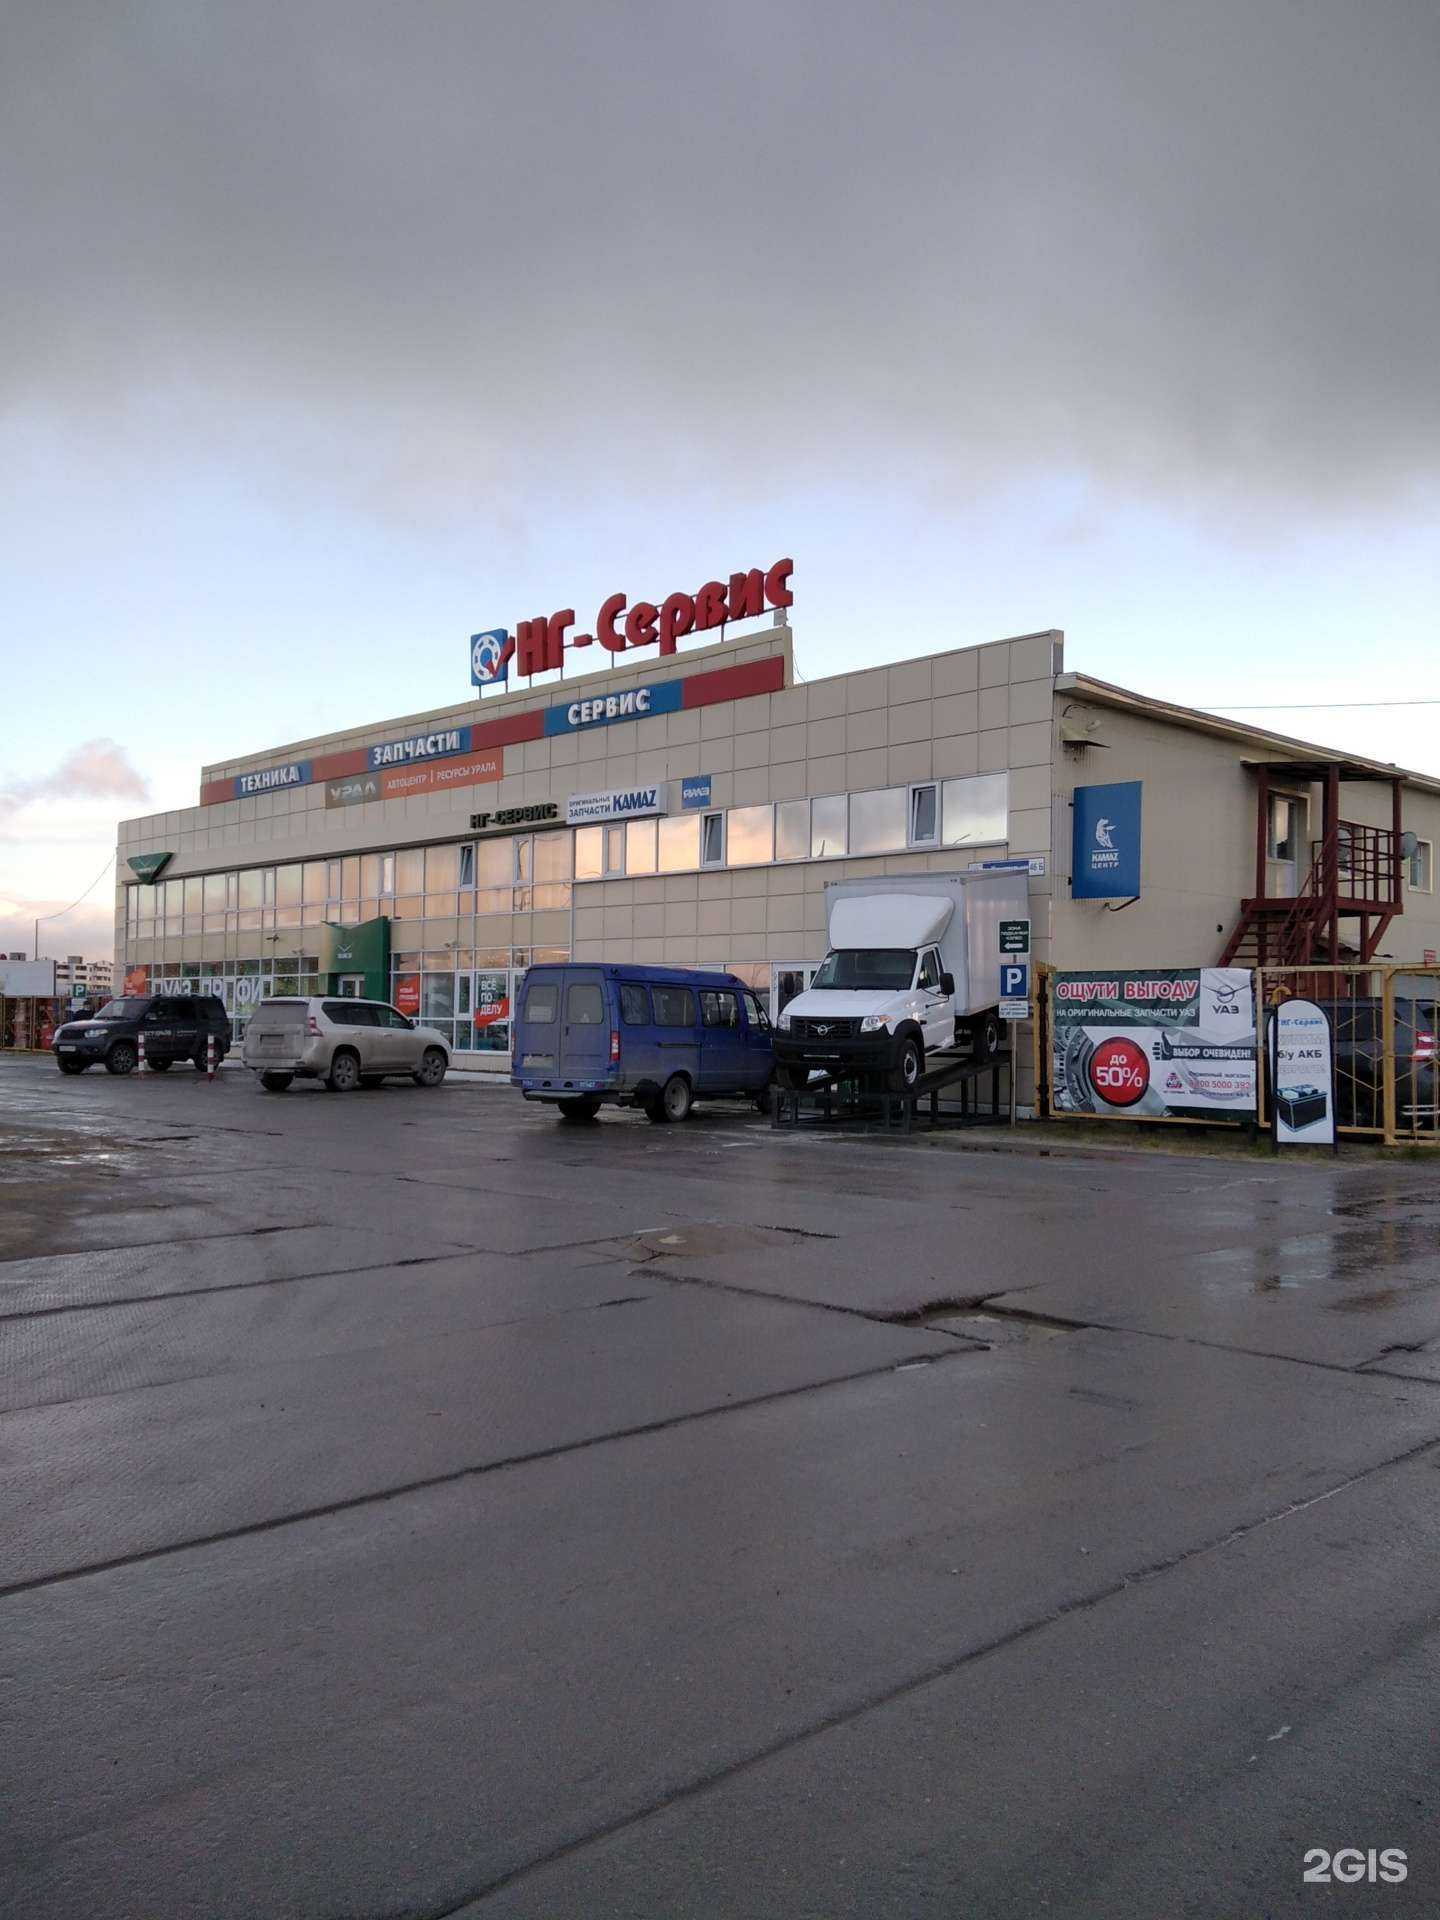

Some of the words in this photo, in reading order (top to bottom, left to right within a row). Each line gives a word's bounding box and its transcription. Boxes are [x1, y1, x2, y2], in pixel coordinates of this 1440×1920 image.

[517, 558, 794, 677] НГ-Сервис
[567, 688, 651, 725] СЕРВИС
[373, 730, 460, 765] ЗАПЧАСТИ
[240, 765, 300, 793] ТЕХНИКА
[437, 767, 469, 782] РЕСУРСЫ
[471, 761, 497, 777] УРАЛА
[330, 782, 377, 800] УРАЛ
[387, 774, 428, 790] АВТОЦЕНТР
[569, 796, 610, 808] ОРИГИНАЛЬНЫЕ
[612, 789, 657, 812] KAMAZ
[470, 803, 558, 829] НГ-СЕРВИС
[569, 806, 610, 818] ЗАПЧАСТИ
[1092, 861, 1119, 869] ЦЕНТР
[481, 977, 497, 991] ВСЁ
[1006, 968, 1022, 993] P
[1056, 980, 1118, 1002] ОЩУТИ
[1125, 979, 1198, 1002] ВЫГОДУ
[480, 1004, 502, 1016] ДЕЛУ
[1056, 1009, 1066, 1017] НА
[1067, 1008, 1132, 1018] ОРИГИНАЛЬНЫЕ
[1134, 1008, 1177, 1018] ЗАПЧАСТИ
[1178, 1007, 1196, 1017] УАЗ
[1212, 1005, 1239, 1015] УАЗ
[1173, 1048, 1200, 1057] ВЫБОР
[1203, 1048, 1251, 1059] ОЧЕВИДЕН!
[1298, 1049, 1322, 1059] АКБ
[1096, 1066, 1143, 1088] 50%
